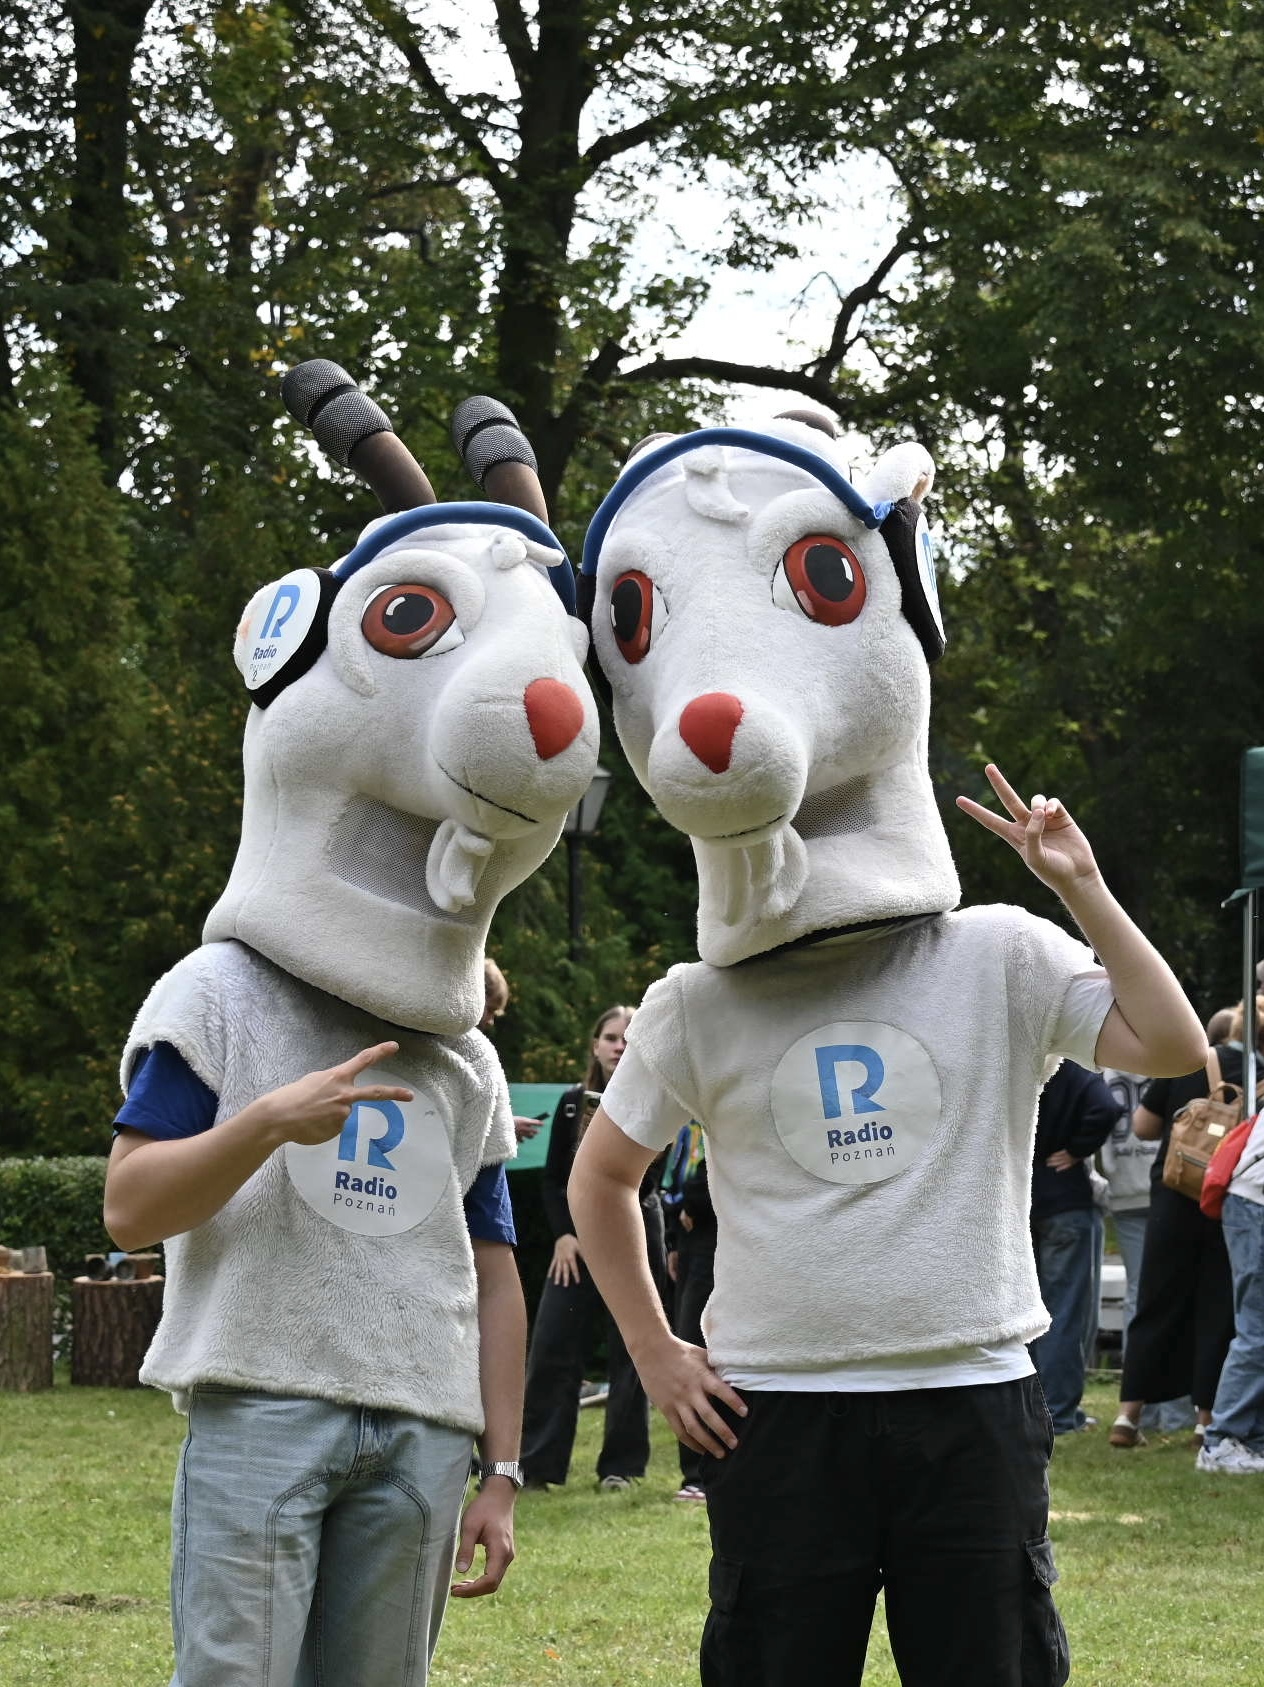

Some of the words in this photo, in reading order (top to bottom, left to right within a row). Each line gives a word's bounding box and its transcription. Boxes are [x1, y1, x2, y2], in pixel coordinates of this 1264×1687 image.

[253, 645, 277, 660] Radio
[827, 1121, 893, 1149] Radio
[831, 1144, 896, 1164] Poznań
[335, 1171, 398, 1200] Radio
[333, 1193, 396, 1217] Poznań
